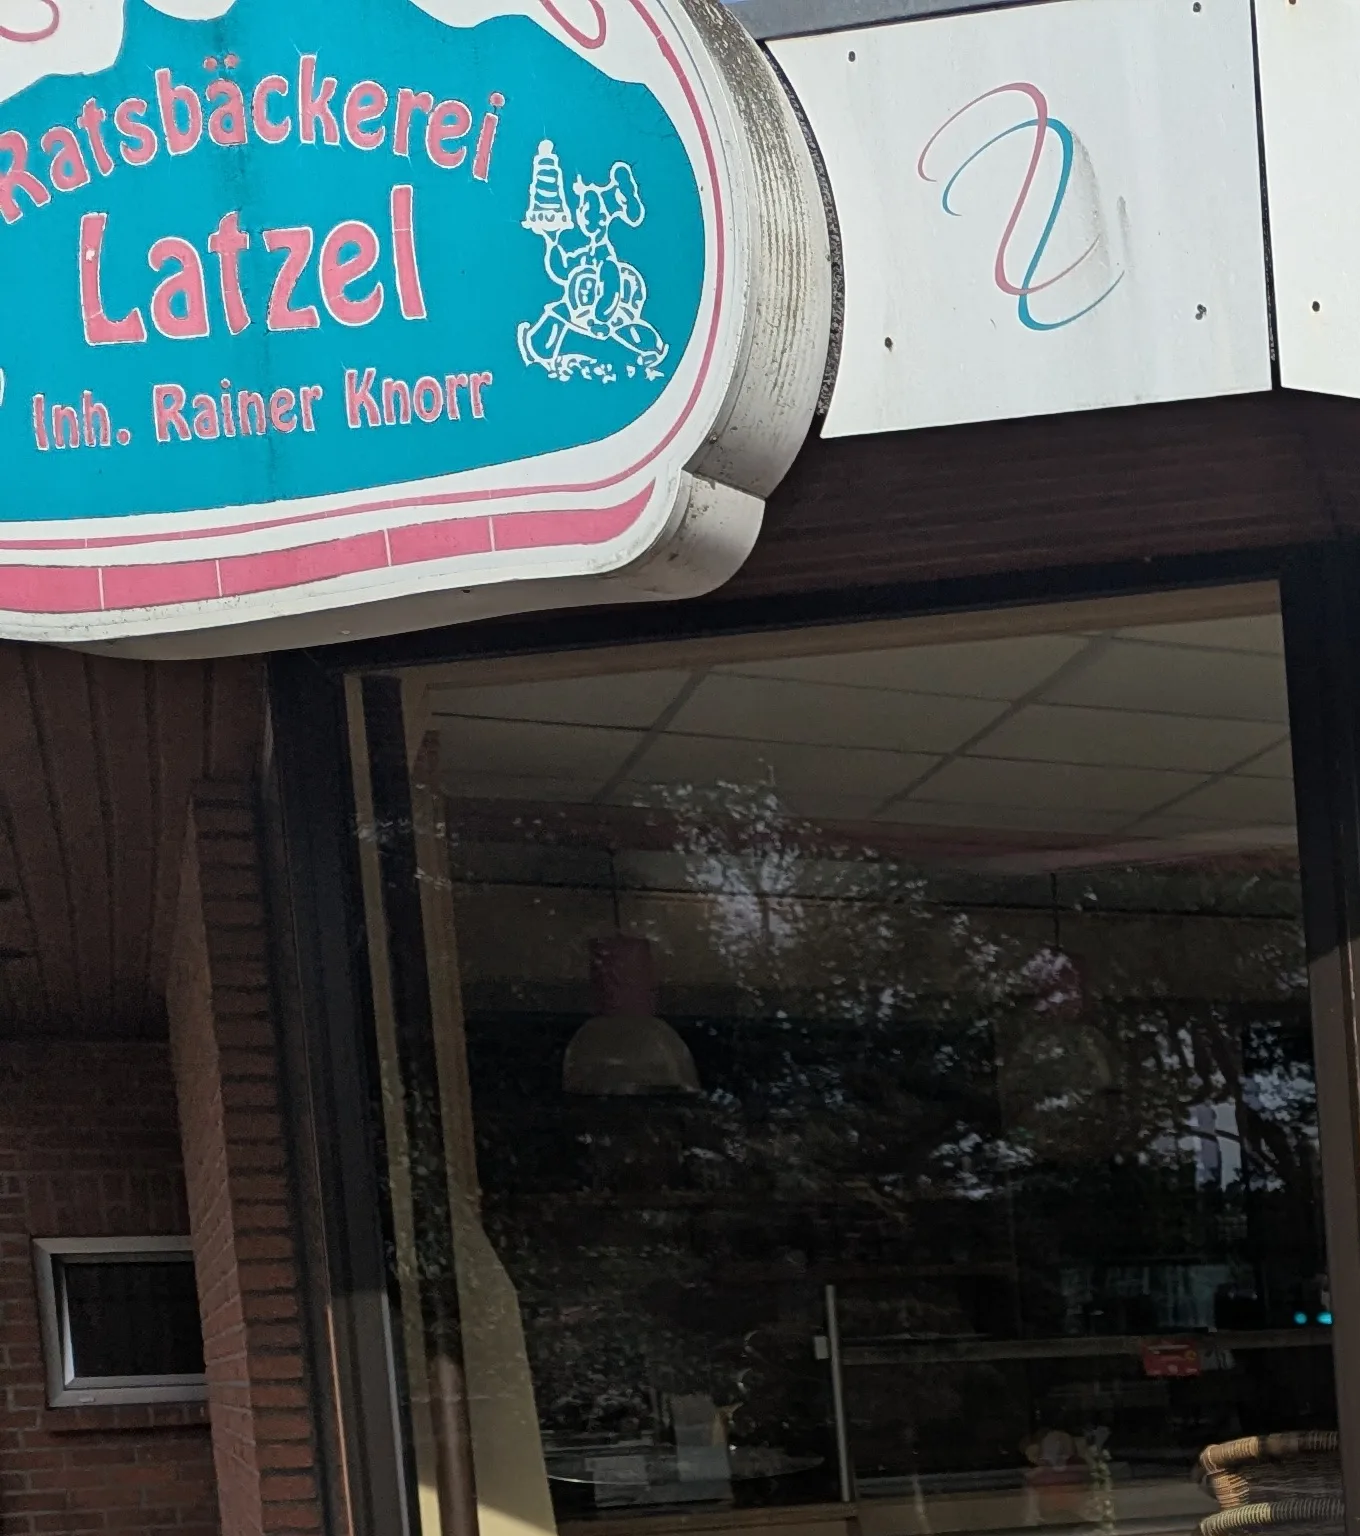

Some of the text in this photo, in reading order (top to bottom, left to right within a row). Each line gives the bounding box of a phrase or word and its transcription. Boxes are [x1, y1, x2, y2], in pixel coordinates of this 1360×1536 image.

[0, 54, 506, 224] Ratsbäckerei
[79, 184, 427, 346] Latzel
[33, 367, 493, 451] Inh. Rainer Knorr
